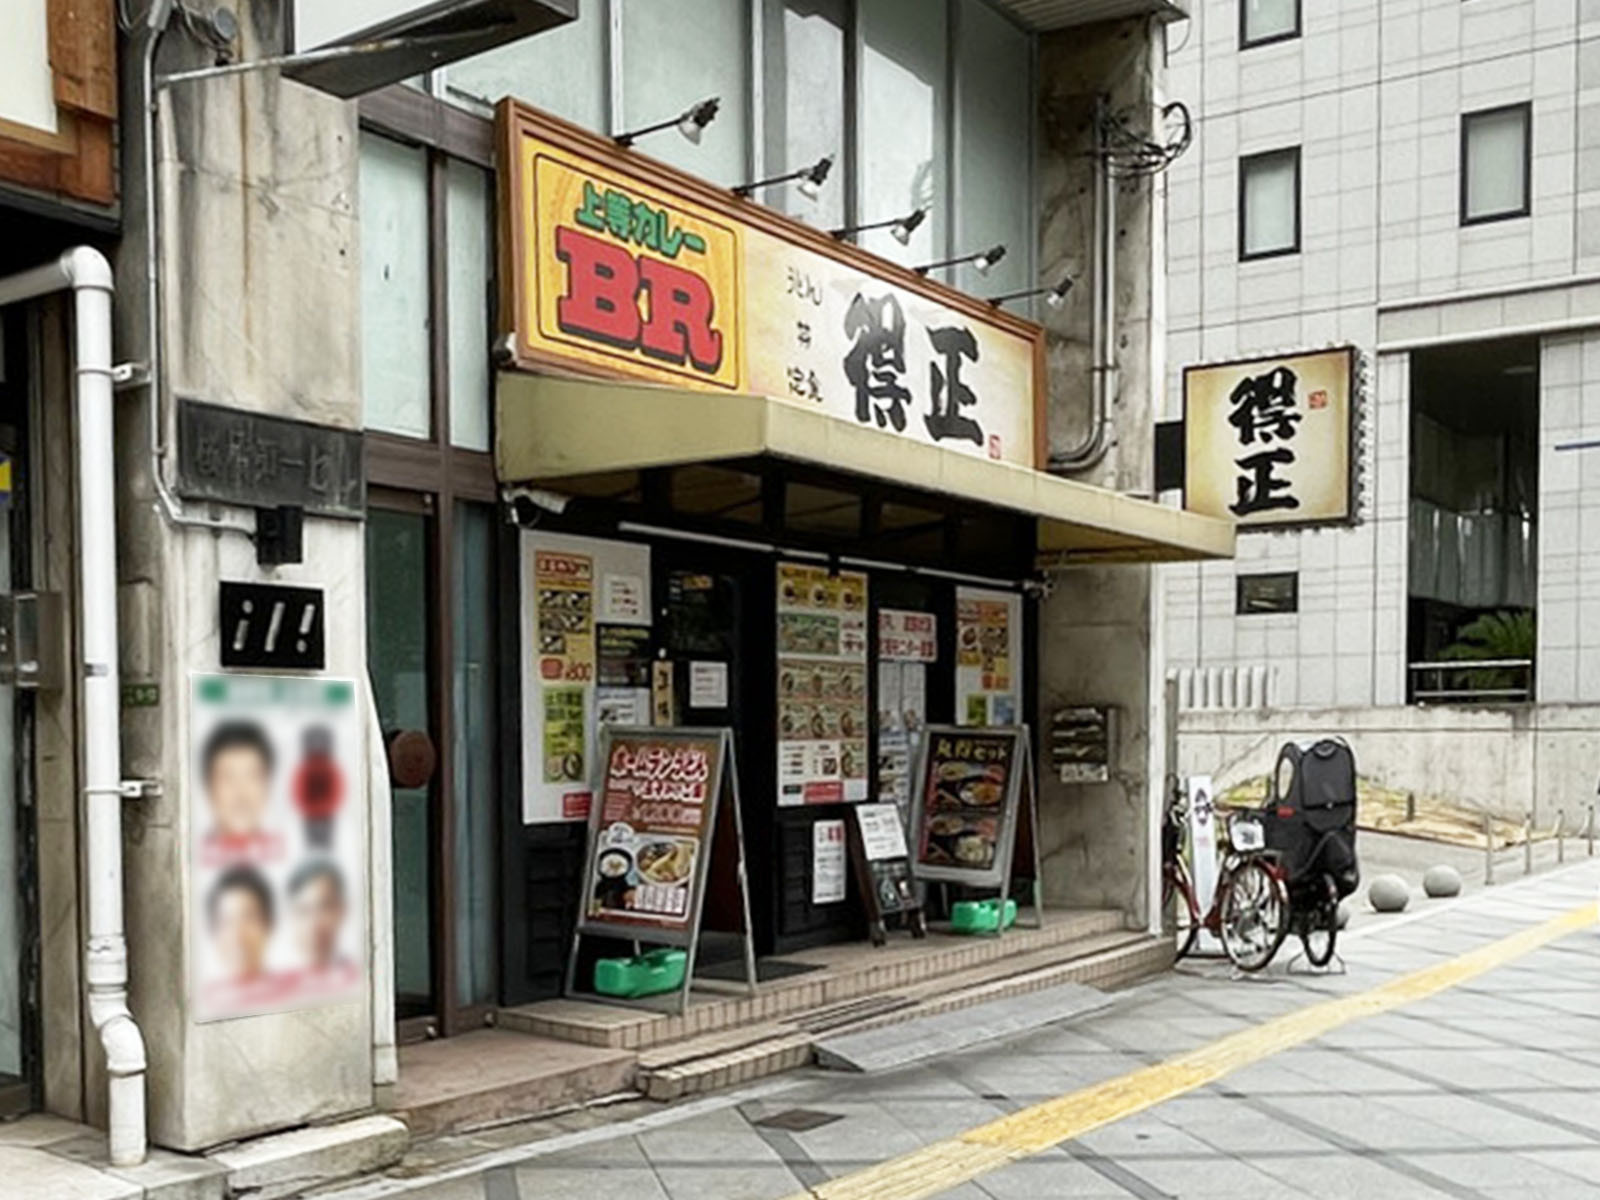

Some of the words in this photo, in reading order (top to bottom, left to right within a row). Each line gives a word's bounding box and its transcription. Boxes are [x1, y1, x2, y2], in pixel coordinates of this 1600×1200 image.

[574, 181, 706, 258] 上等カレー
[556, 225, 723, 374] BR
[843, 292, 984, 447] 得正
[1228, 366, 1303, 517] 得正
